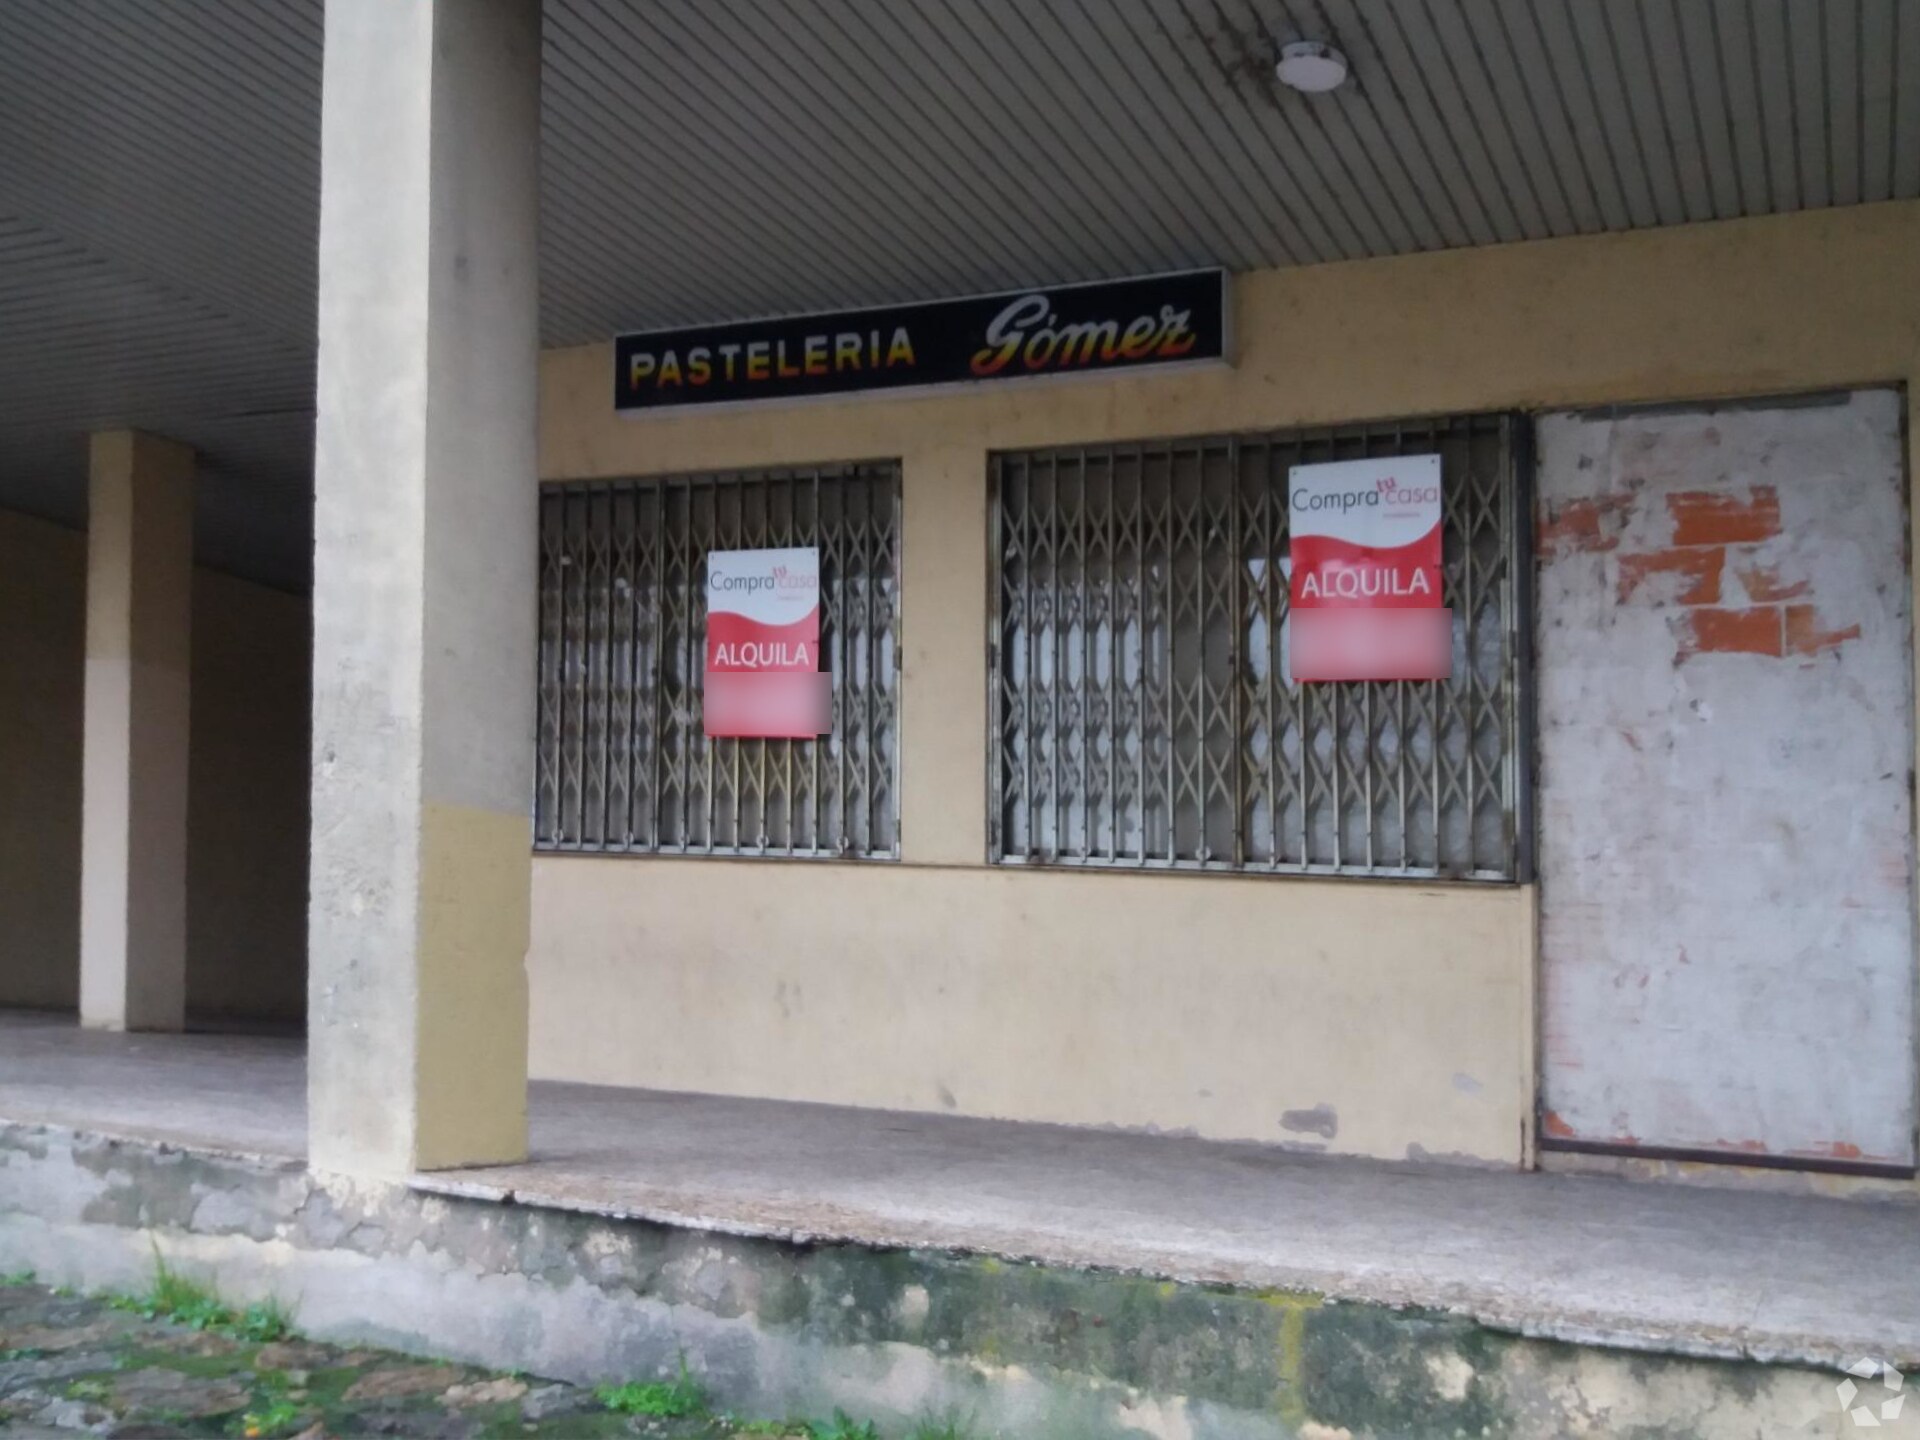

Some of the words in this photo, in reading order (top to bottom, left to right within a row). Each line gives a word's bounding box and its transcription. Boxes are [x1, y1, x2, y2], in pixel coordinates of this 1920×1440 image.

[631, 328, 915, 390] PASTELERIA
[969, 294, 1197, 376] Gómez
[1376, 476, 1396, 493] tu
[1385, 486, 1438, 505] casa
[1292, 488, 1379, 515] Compra
[710, 571, 775, 595] Compra
[1301, 567, 1430, 599] ALQUILA
[714, 642, 810, 668] ALQUILA
